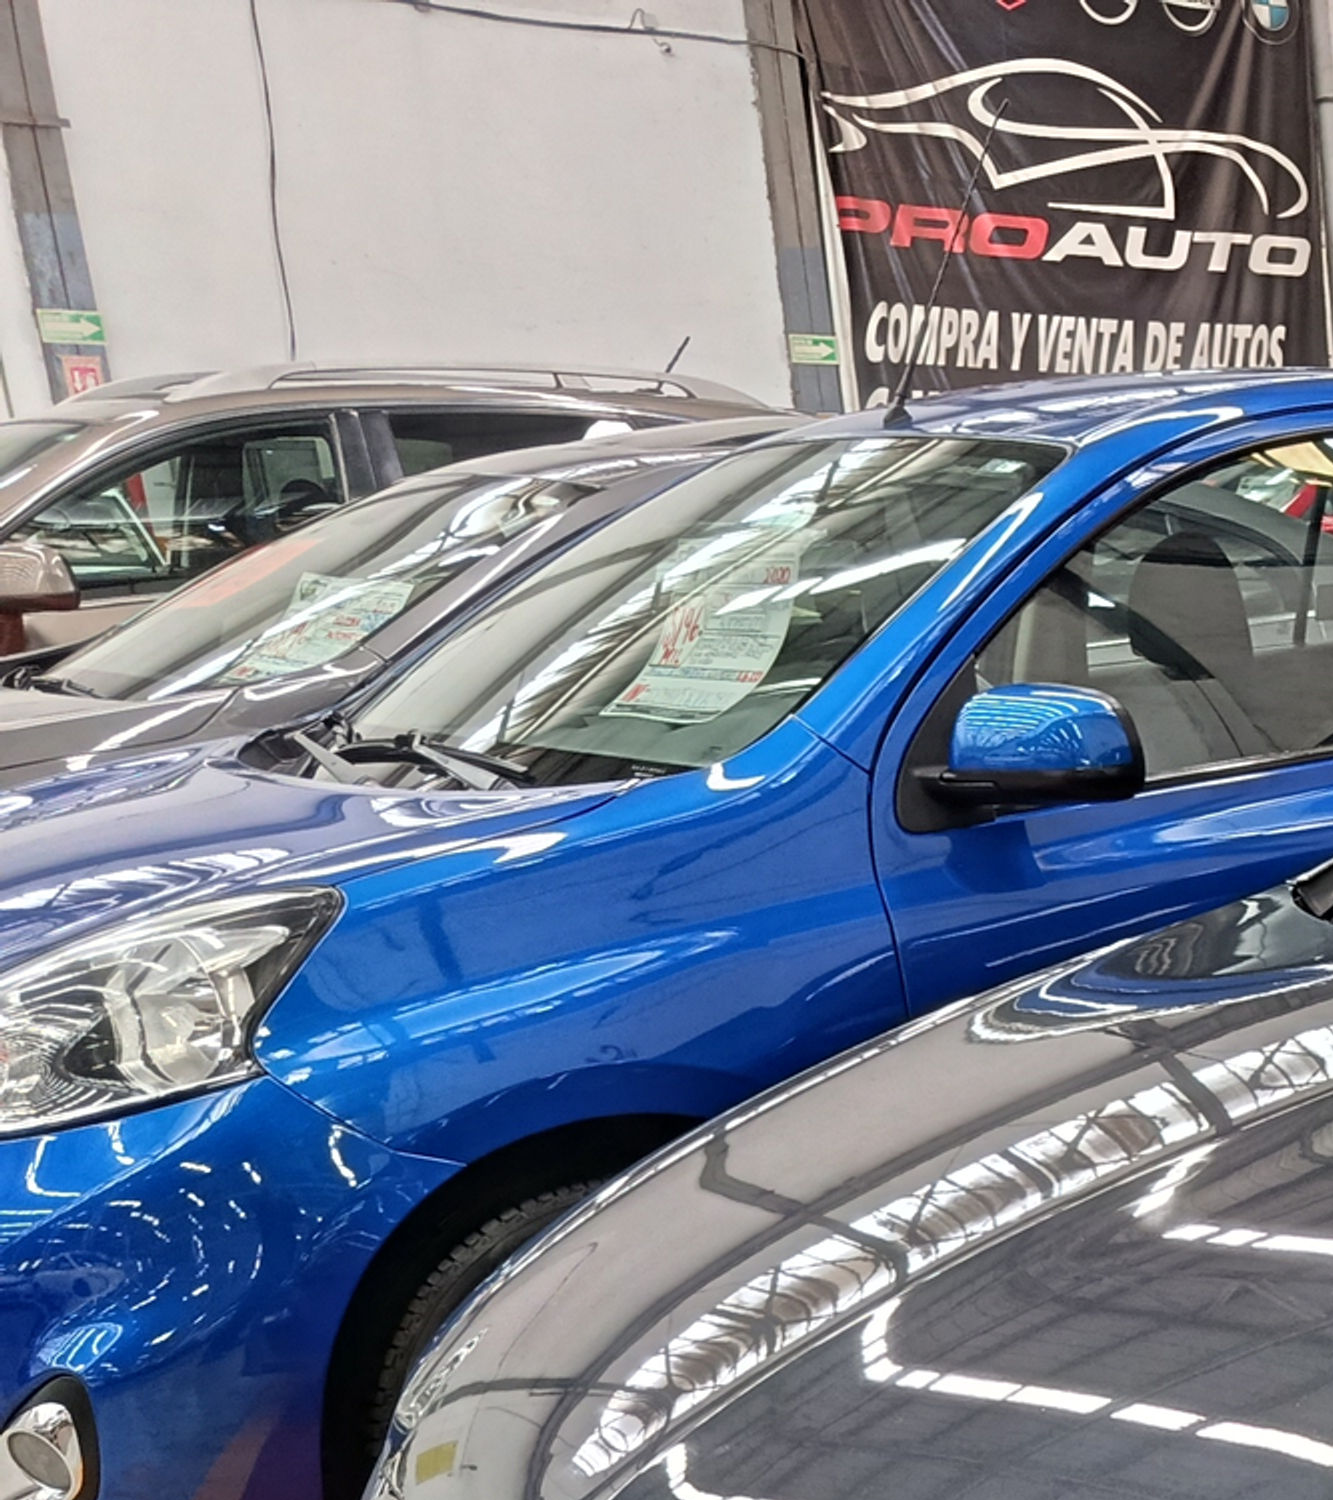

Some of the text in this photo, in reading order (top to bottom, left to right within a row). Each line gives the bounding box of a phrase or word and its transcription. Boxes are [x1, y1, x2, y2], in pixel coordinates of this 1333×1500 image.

[866, 301, 1286, 374] COMPRA Y VENTA DE AUTOS
